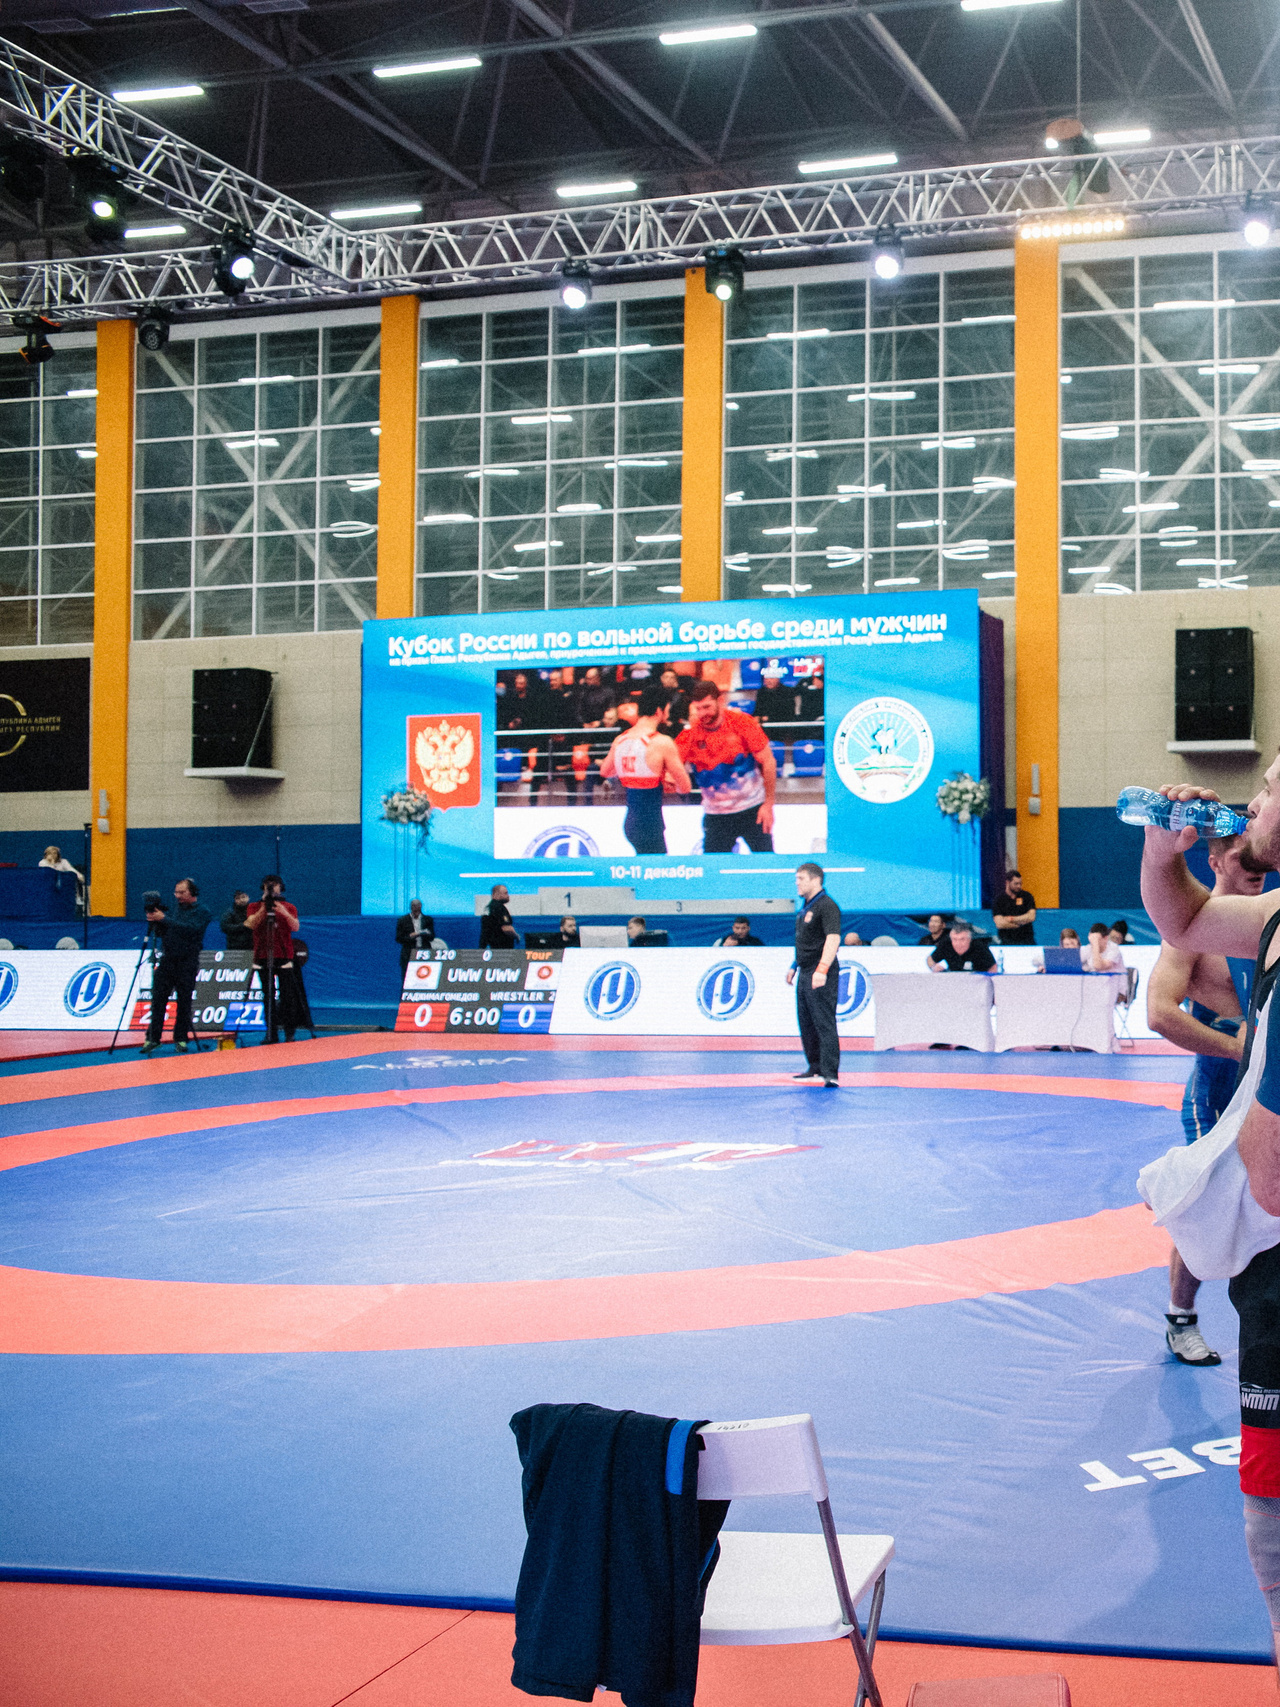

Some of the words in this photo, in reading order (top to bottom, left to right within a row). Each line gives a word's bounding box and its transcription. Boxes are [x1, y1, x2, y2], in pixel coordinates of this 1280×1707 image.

[388, 635, 454, 657] Кубок
[459, 632, 538, 652] России
[543, 631, 572, 649] по
[577, 621, 674, 648] вольной
[679, 618, 766, 643] борьбе
[771, 618, 844, 640] среди
[850, 613, 947, 636] мужчин
[609, 866, 641, 878] 10-11
[644, 865, 704, 879] декабря
[564, 892, 572, 908] 1
[416, 950, 431, 960] FS
[435, 950, 456, 961] 120
[482, 950, 493, 961] 0
[215, 968, 249, 982] UWW
[447, 968, 483, 982] UWW
[485, 968, 521, 982] UWW
[490, 991, 545, 1001] WRESTLER
[235, 1004, 265, 1024] 21
[414, 1003, 432, 1027] 0
[449, 1007, 500, 1026] 6:00
[517, 1004, 537, 1028] 0
